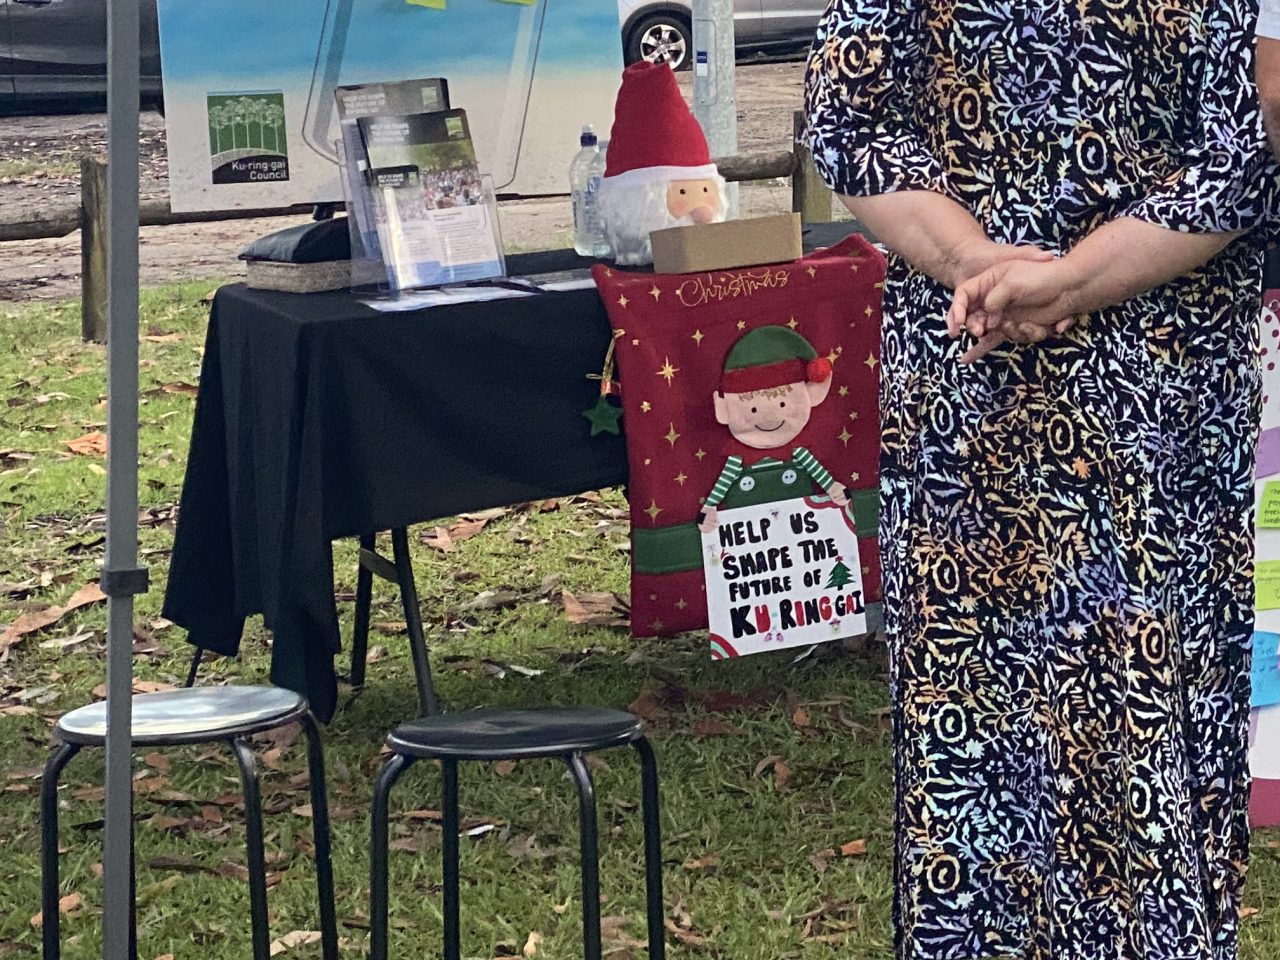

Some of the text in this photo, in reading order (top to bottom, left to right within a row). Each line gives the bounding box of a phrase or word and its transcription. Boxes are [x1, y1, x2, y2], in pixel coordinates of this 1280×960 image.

[249, 170, 287, 180] Council
[680, 267, 791, 307] Christmas
[718, 511, 819, 548] HELP US
[722, 538, 839, 580] SHAPE THE
[729, 569, 822, 602] FUTURE OF
[729, 590, 866, 639] KU RING GAI
